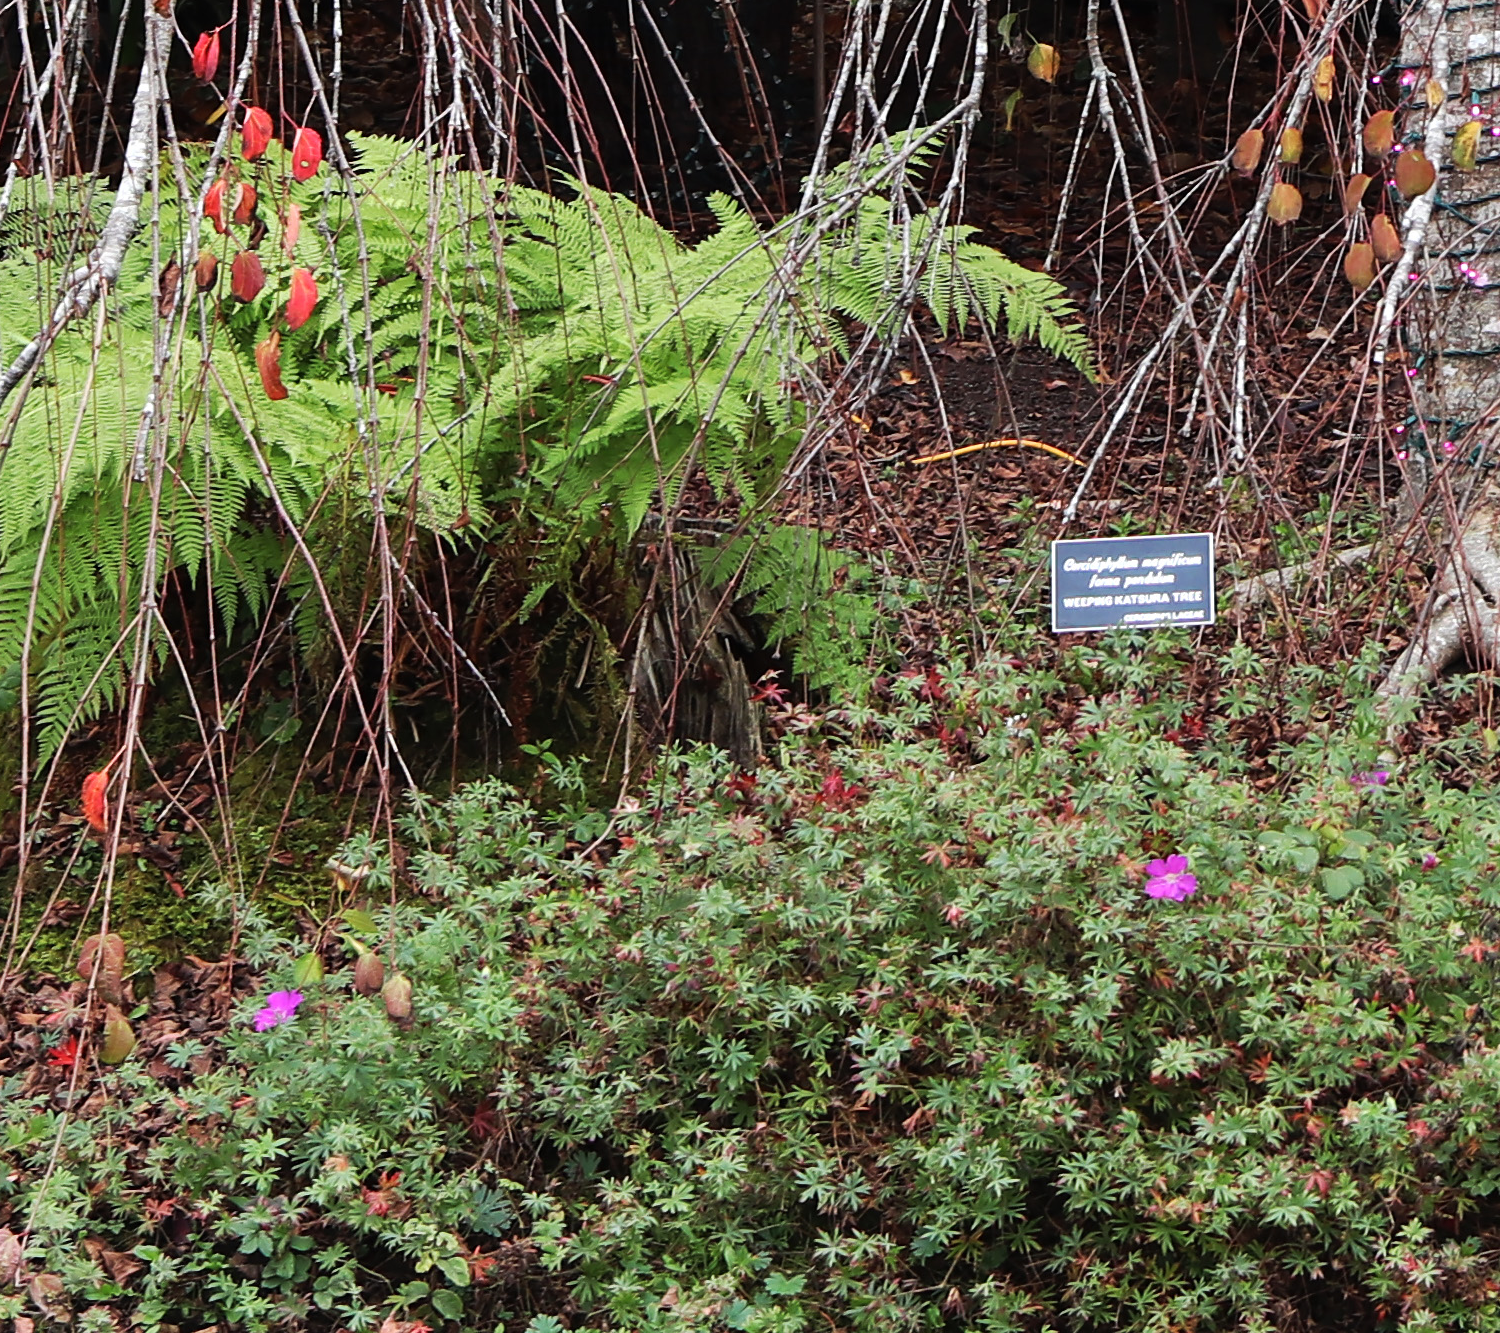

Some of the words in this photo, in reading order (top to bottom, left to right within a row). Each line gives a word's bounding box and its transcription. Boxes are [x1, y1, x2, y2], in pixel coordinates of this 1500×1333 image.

[1141, 552, 1202, 570] magnificum
[1088, 574, 1120, 588] forma
[1123, 571, 1175, 589] pendulum
[1063, 595, 1113, 608] WEEPING
[1114, 593, 1170, 605] KATSURA
[1172, 591, 1202, 602] TREE
